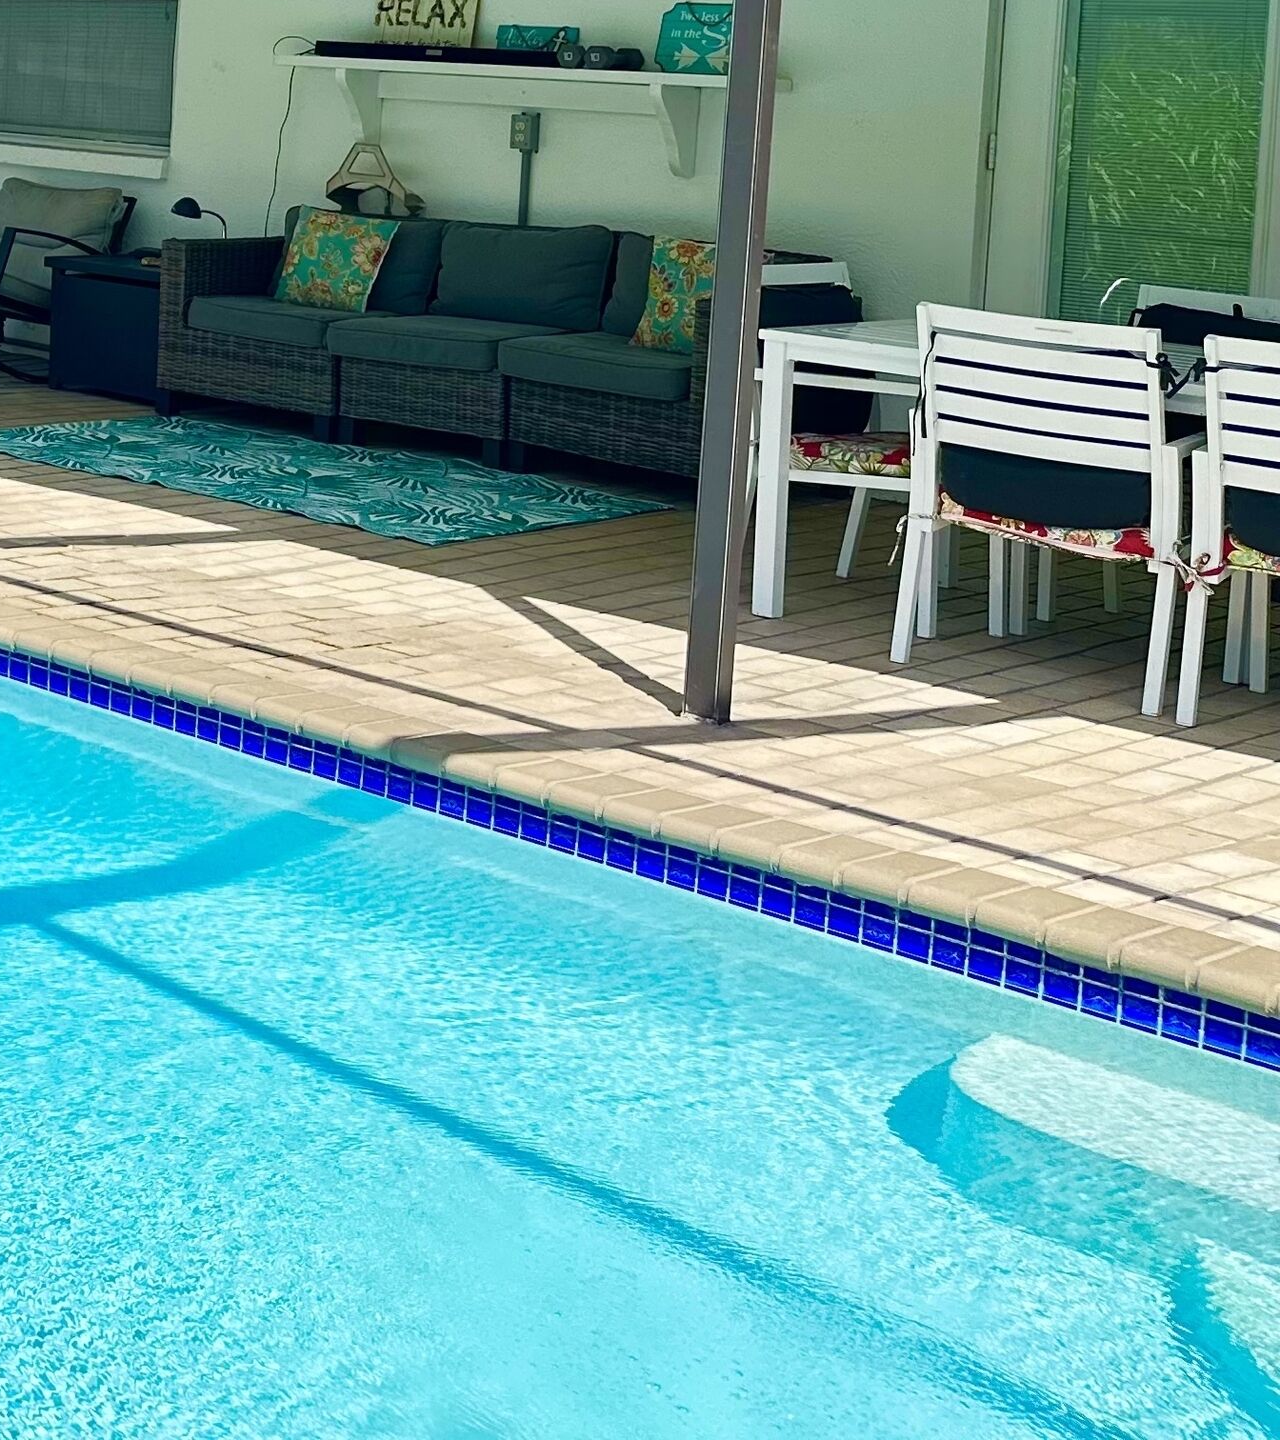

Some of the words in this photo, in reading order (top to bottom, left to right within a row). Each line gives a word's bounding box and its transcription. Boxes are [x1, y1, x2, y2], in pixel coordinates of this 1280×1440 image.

[701, 11, 720, 22] less
[670, 29, 681, 38] in
[683, 29, 702, 39] the
